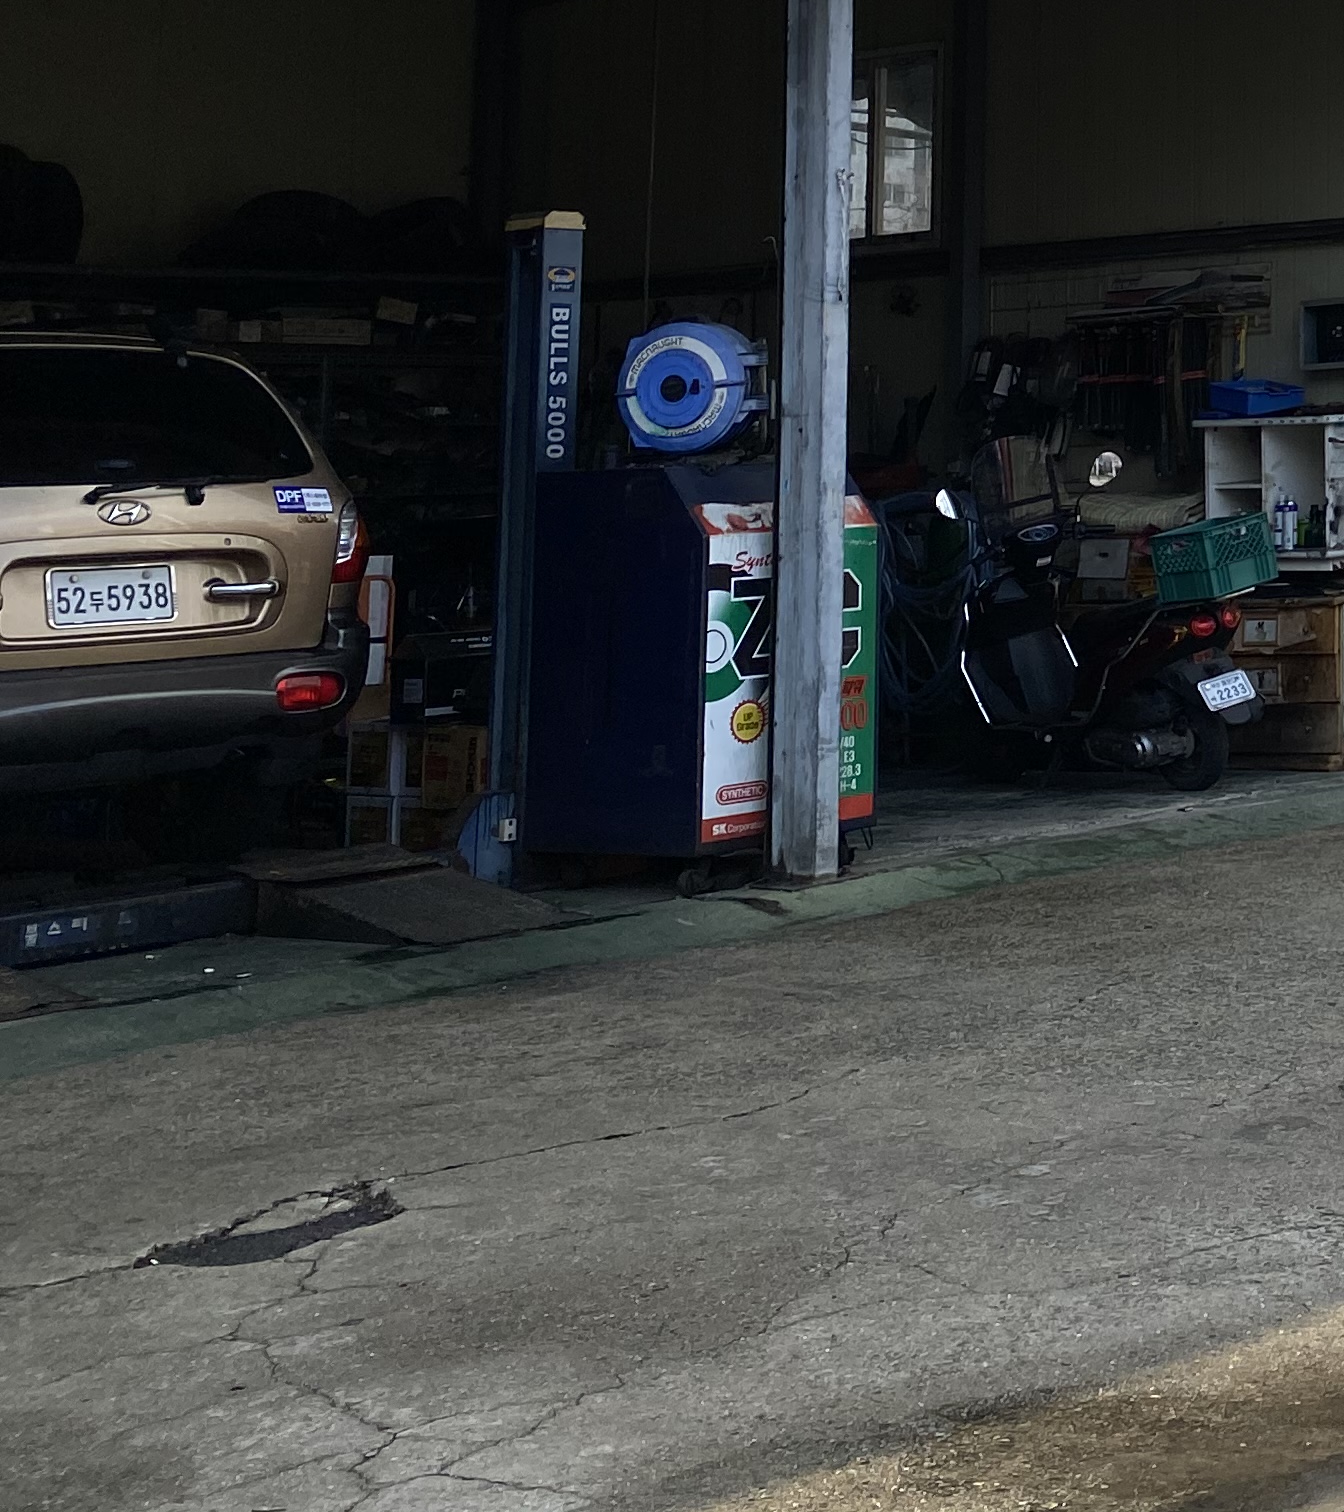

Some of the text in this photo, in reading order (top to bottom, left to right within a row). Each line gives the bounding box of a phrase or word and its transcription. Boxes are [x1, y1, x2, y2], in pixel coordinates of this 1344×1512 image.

[549, 306, 571, 386] BULLS
[545, 395, 567, 460] 5000
[275, 489, 303, 503] DPF
[57, 582, 169, 615] 52두5938
[712, 823, 727, 836] SK
